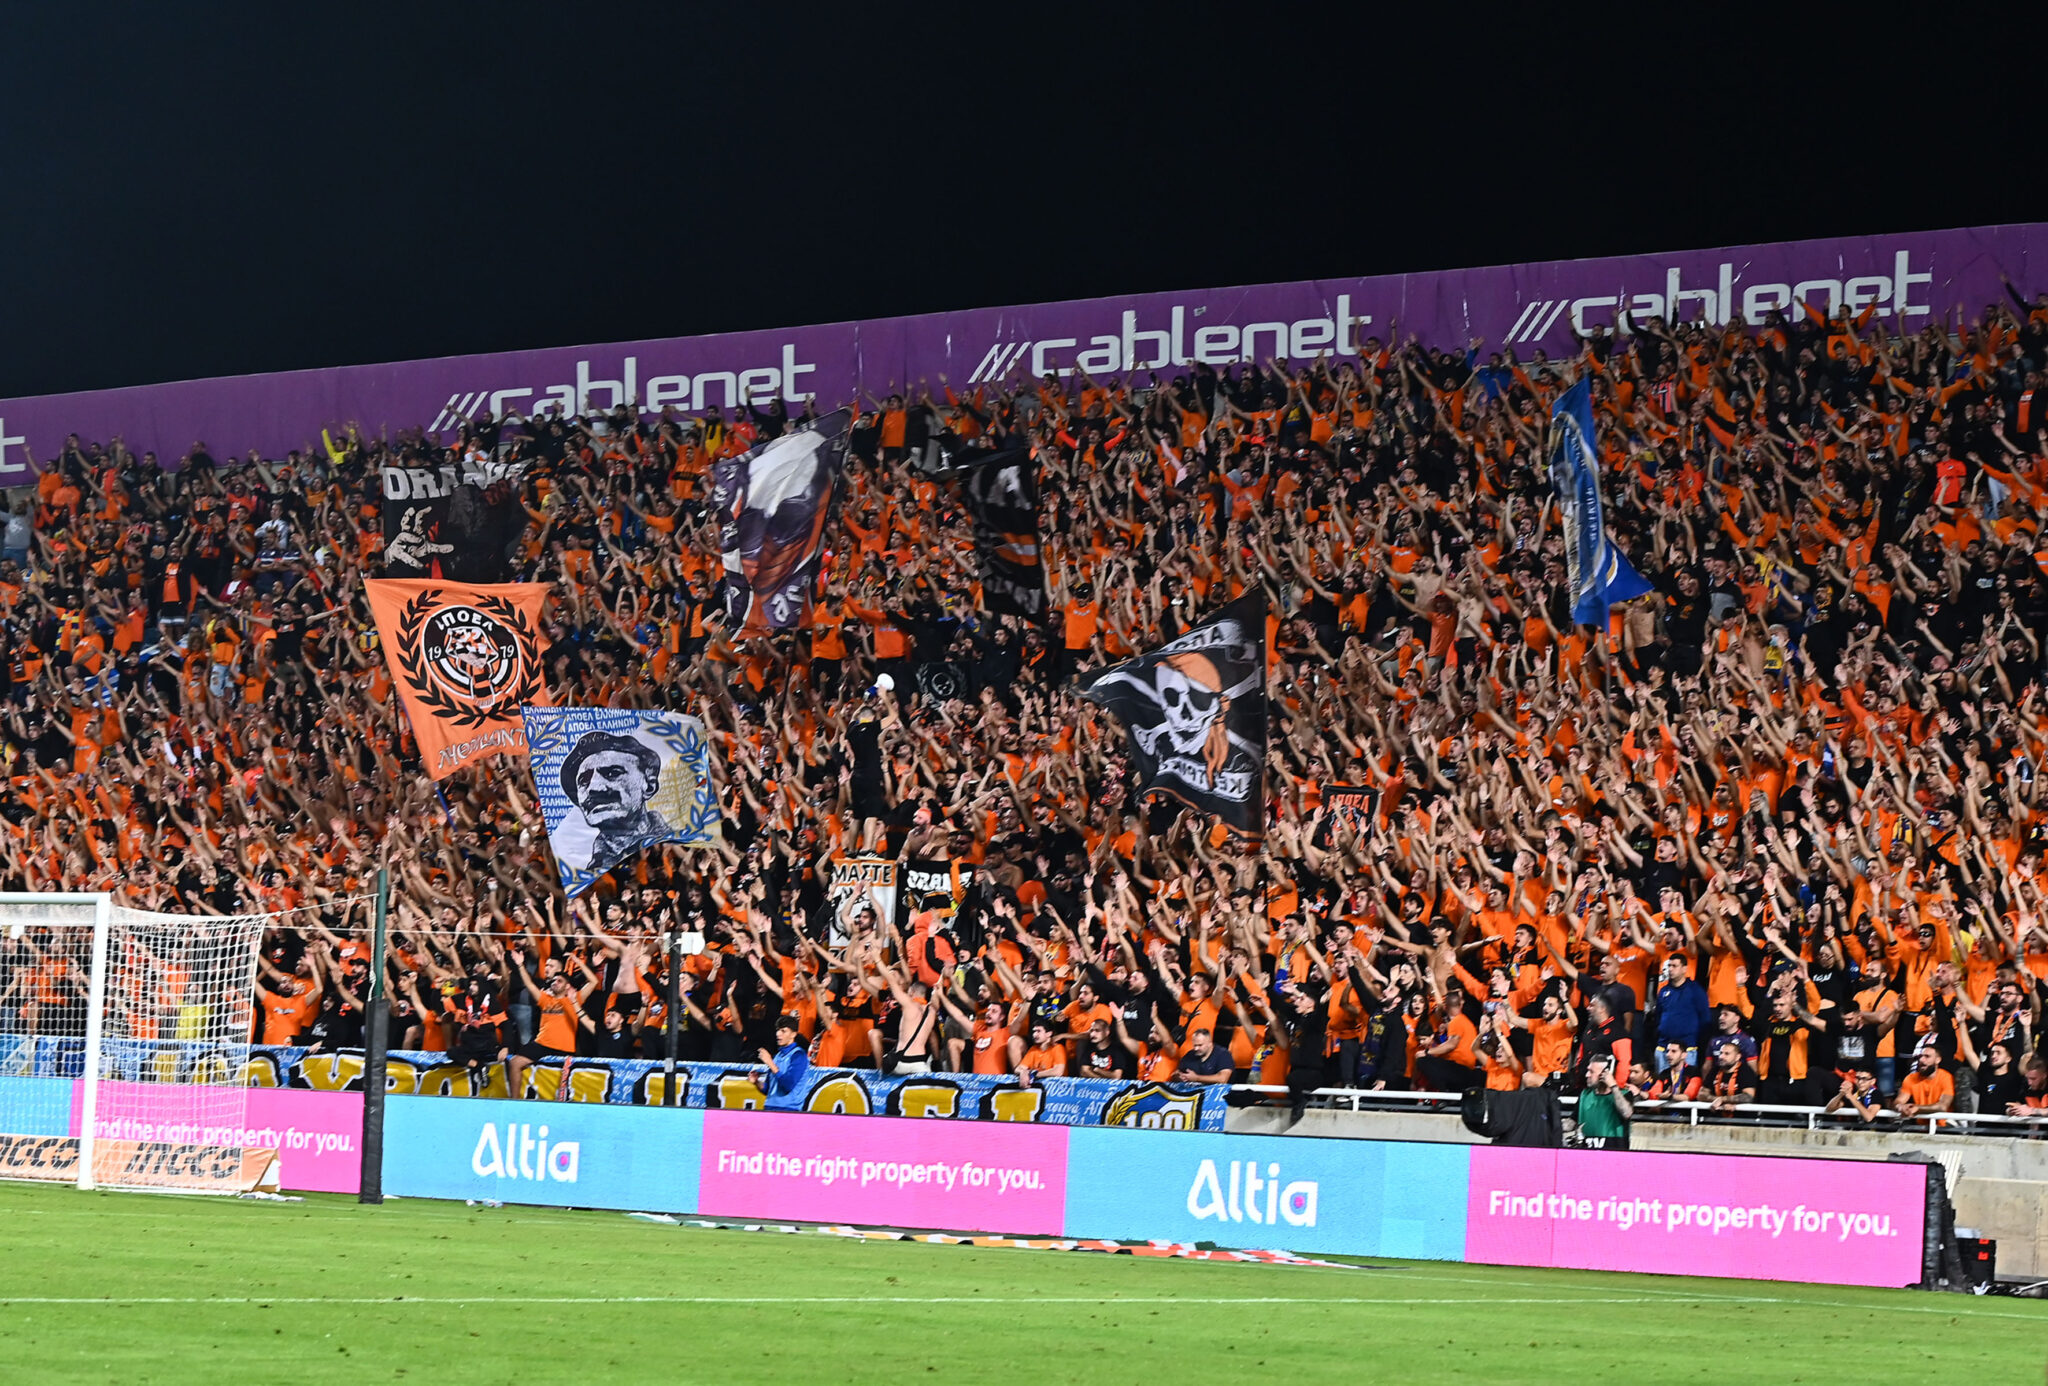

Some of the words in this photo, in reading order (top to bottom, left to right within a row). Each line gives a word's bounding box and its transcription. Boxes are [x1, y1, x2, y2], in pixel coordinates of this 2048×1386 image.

[1031, 294, 1372, 379] cablenet
[489, 343, 817, 425] cablenet
[428, 646, 443, 660] 19
[500, 645, 515, 659] 79
[93, 1116, 121, 1139] ind
[123, 1118, 153, 1141] the
[156, 1121, 200, 1147] right
[203, 1125, 283, 1150] property
[285, 1127, 314, 1149] for
[315, 1133, 355, 1156] you.
[471, 1122, 580, 1183] Altia
[718, 1150, 763, 1174] Find
[765, 1153, 802, 1176] the
[805, 1155, 858, 1184] right
[861, 1161, 957, 1191] property
[960, 1162, 996, 1186] for
[998, 1170, 1046, 1195] you.
[1186, 1159, 1319, 1228] Altia
[1488, 1190, 1544, 1218] Find
[1546, 1194, 1593, 1220] the
[1597, 1196, 1662, 1230] right
[1667, 1204, 1788, 1236] property
[1791, 1205, 1834, 1233] for
[1837, 1212, 1899, 1242] you.
